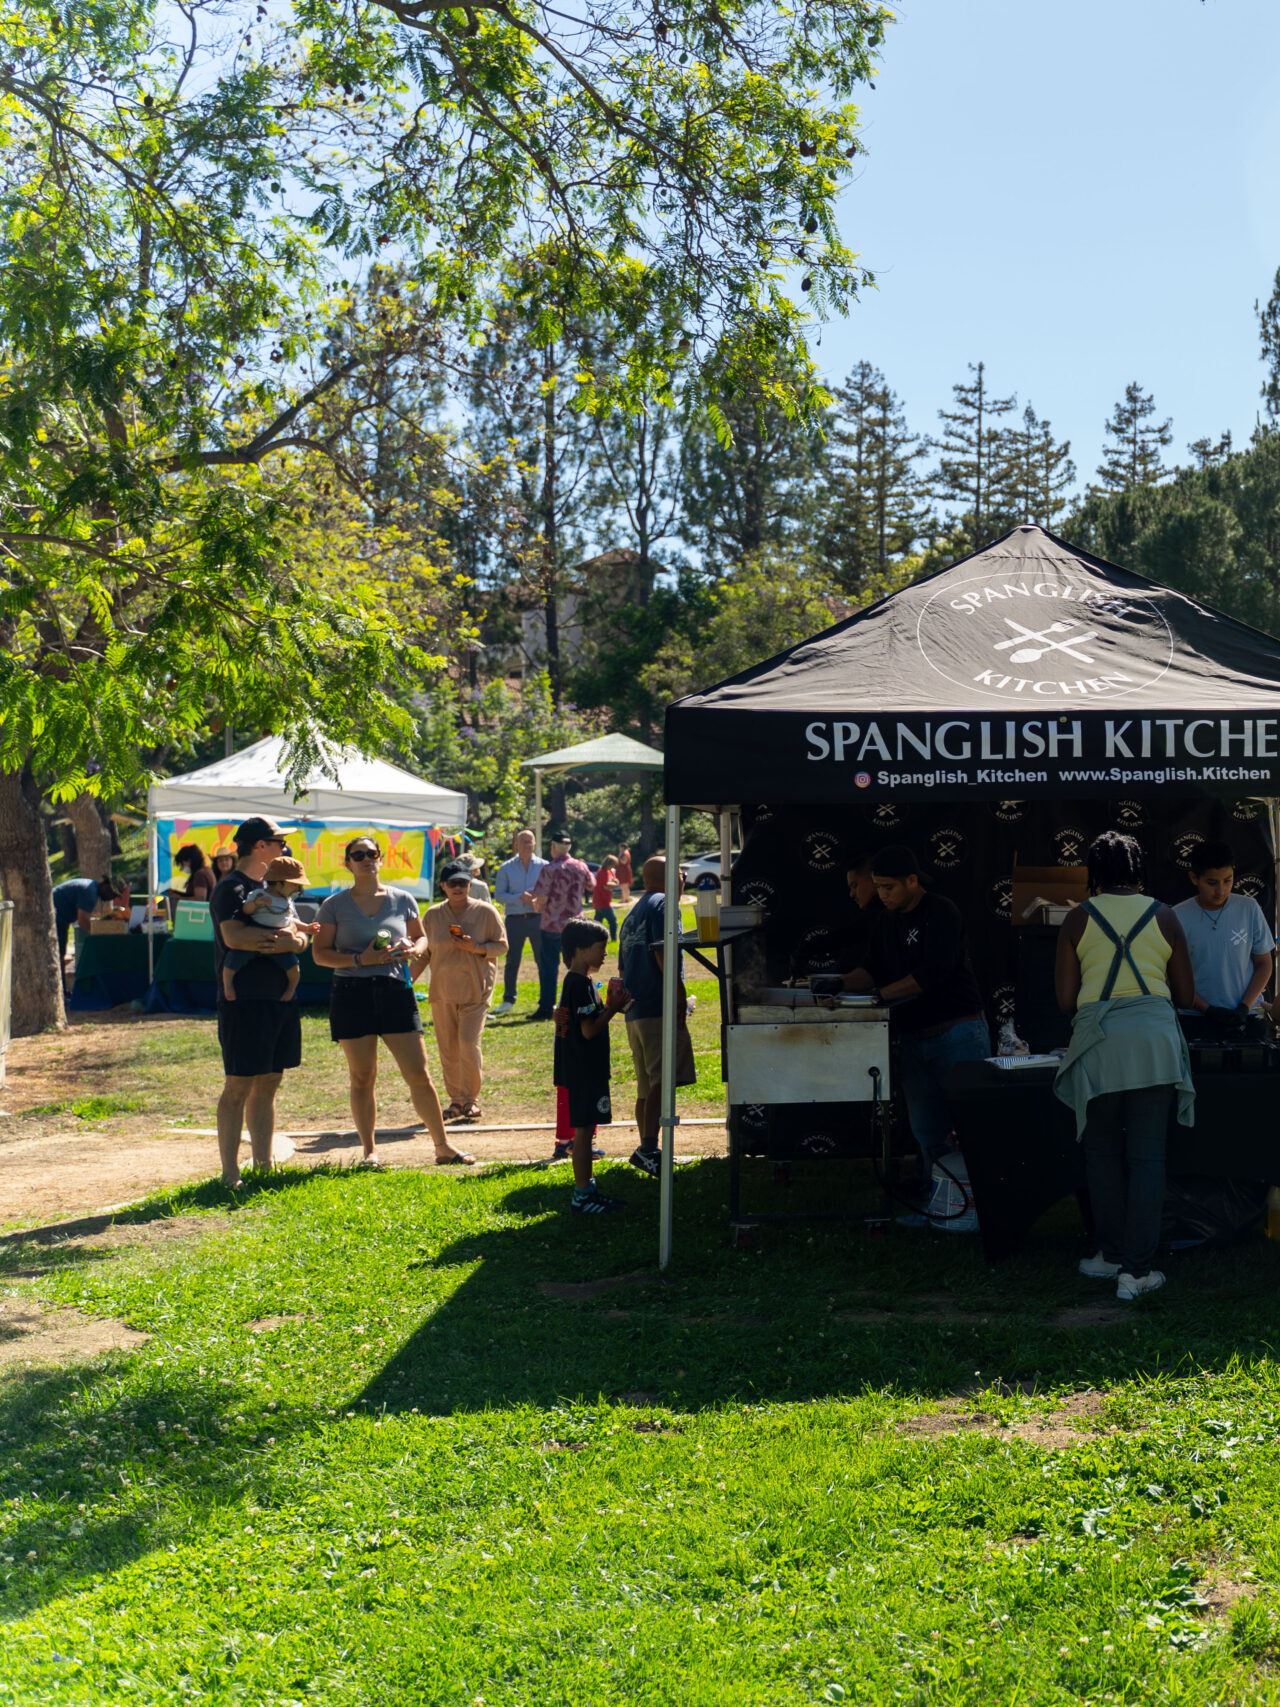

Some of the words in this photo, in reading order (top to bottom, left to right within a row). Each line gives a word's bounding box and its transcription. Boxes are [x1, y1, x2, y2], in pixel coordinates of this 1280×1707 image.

[950, 582, 1133, 616] SPANGLISH
[973, 669, 1134, 695] KITCHEN
[805, 720, 1083, 762] SPANGLISH
[877, 769, 1048, 787] Spanglish_Kitchen
[1058, 766, 1271, 784] www.Spanglish.Kitchen
